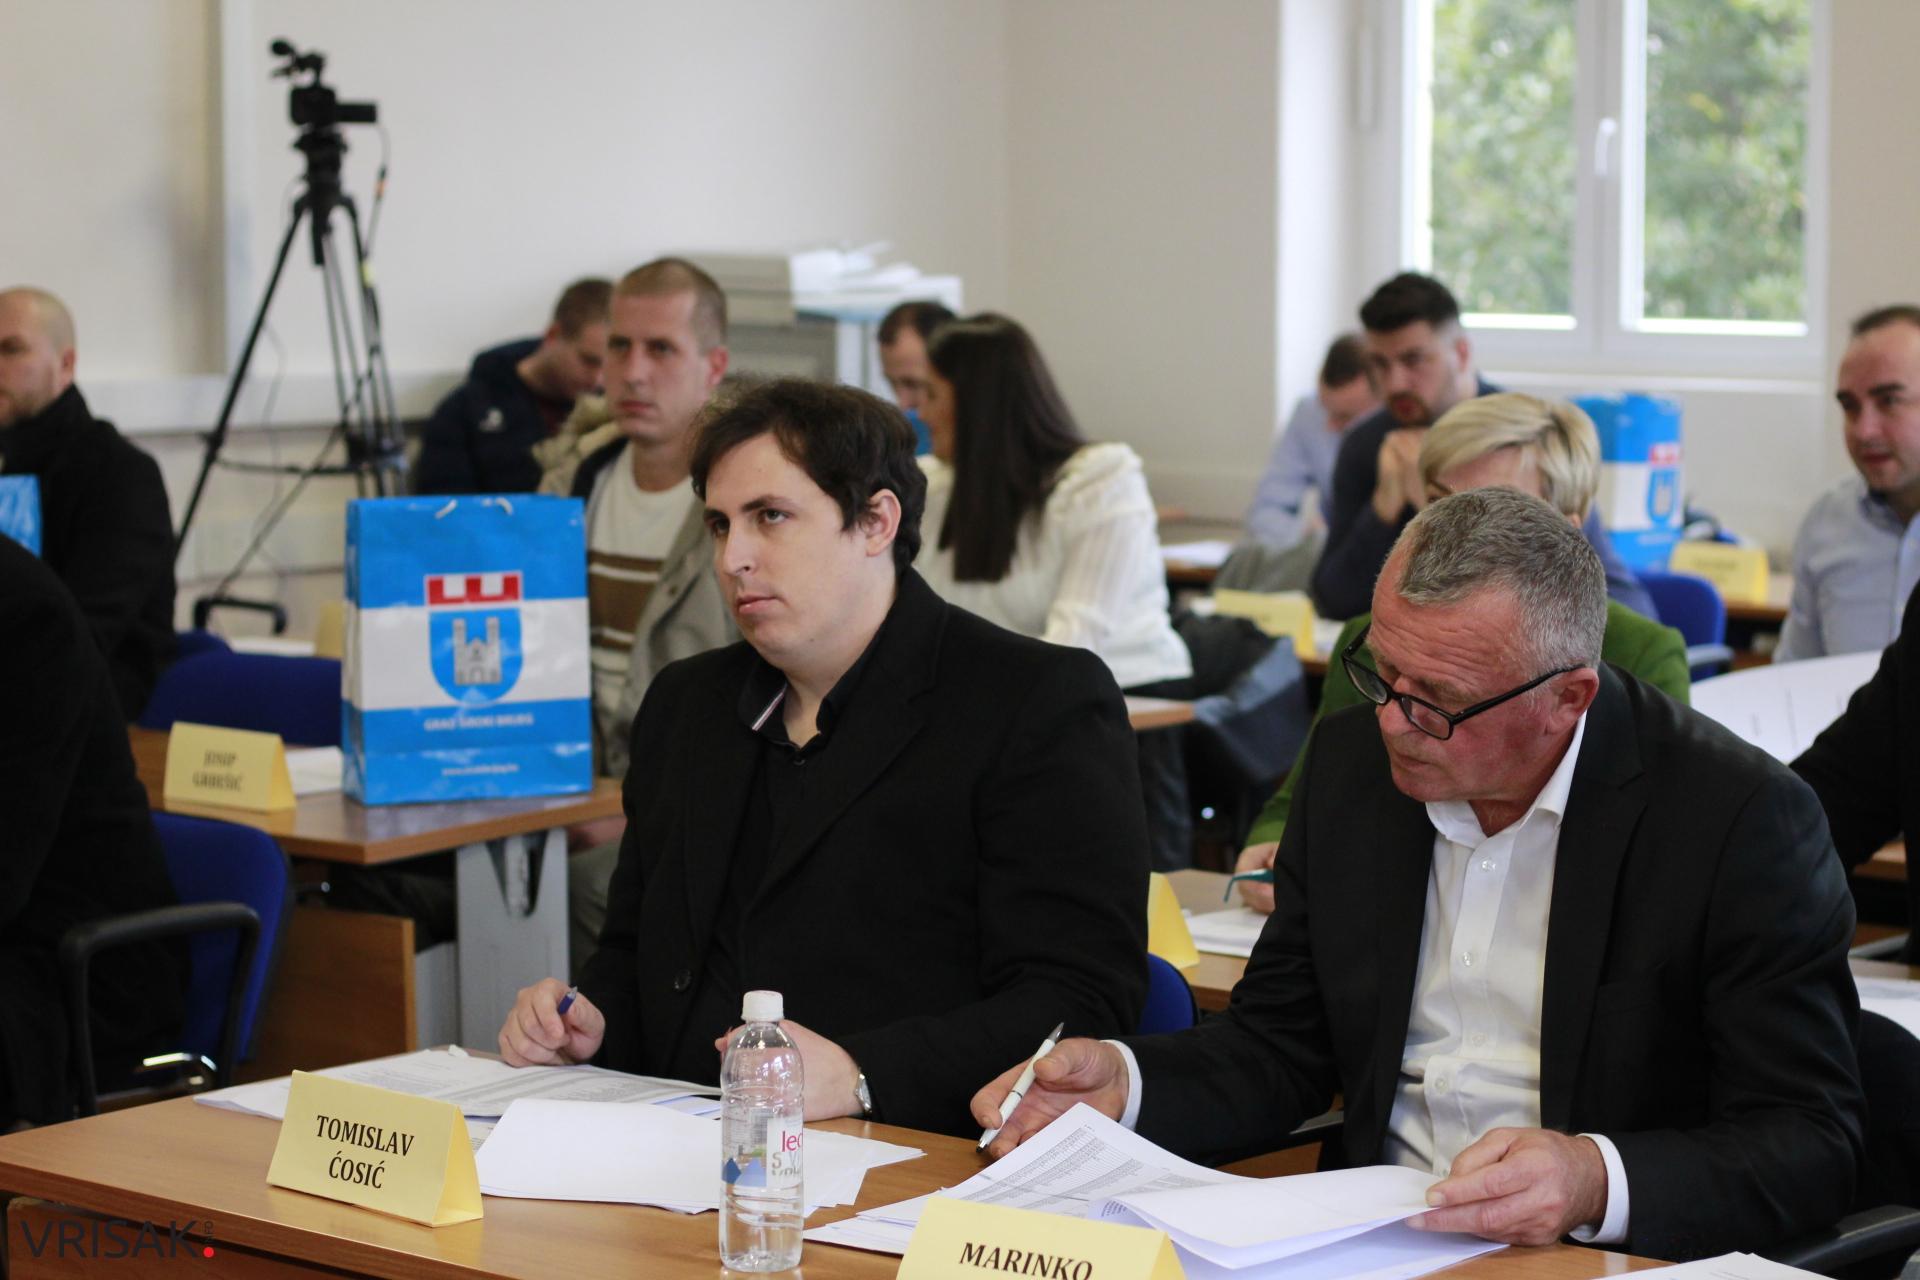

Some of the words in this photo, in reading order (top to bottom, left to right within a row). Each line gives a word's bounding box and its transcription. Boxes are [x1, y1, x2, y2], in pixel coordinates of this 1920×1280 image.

[316, 1114, 415, 1157] TOMISLAV
[328, 1150, 386, 1190] ĆOSIĆ
[958, 1241, 1093, 1280] MARINKO
